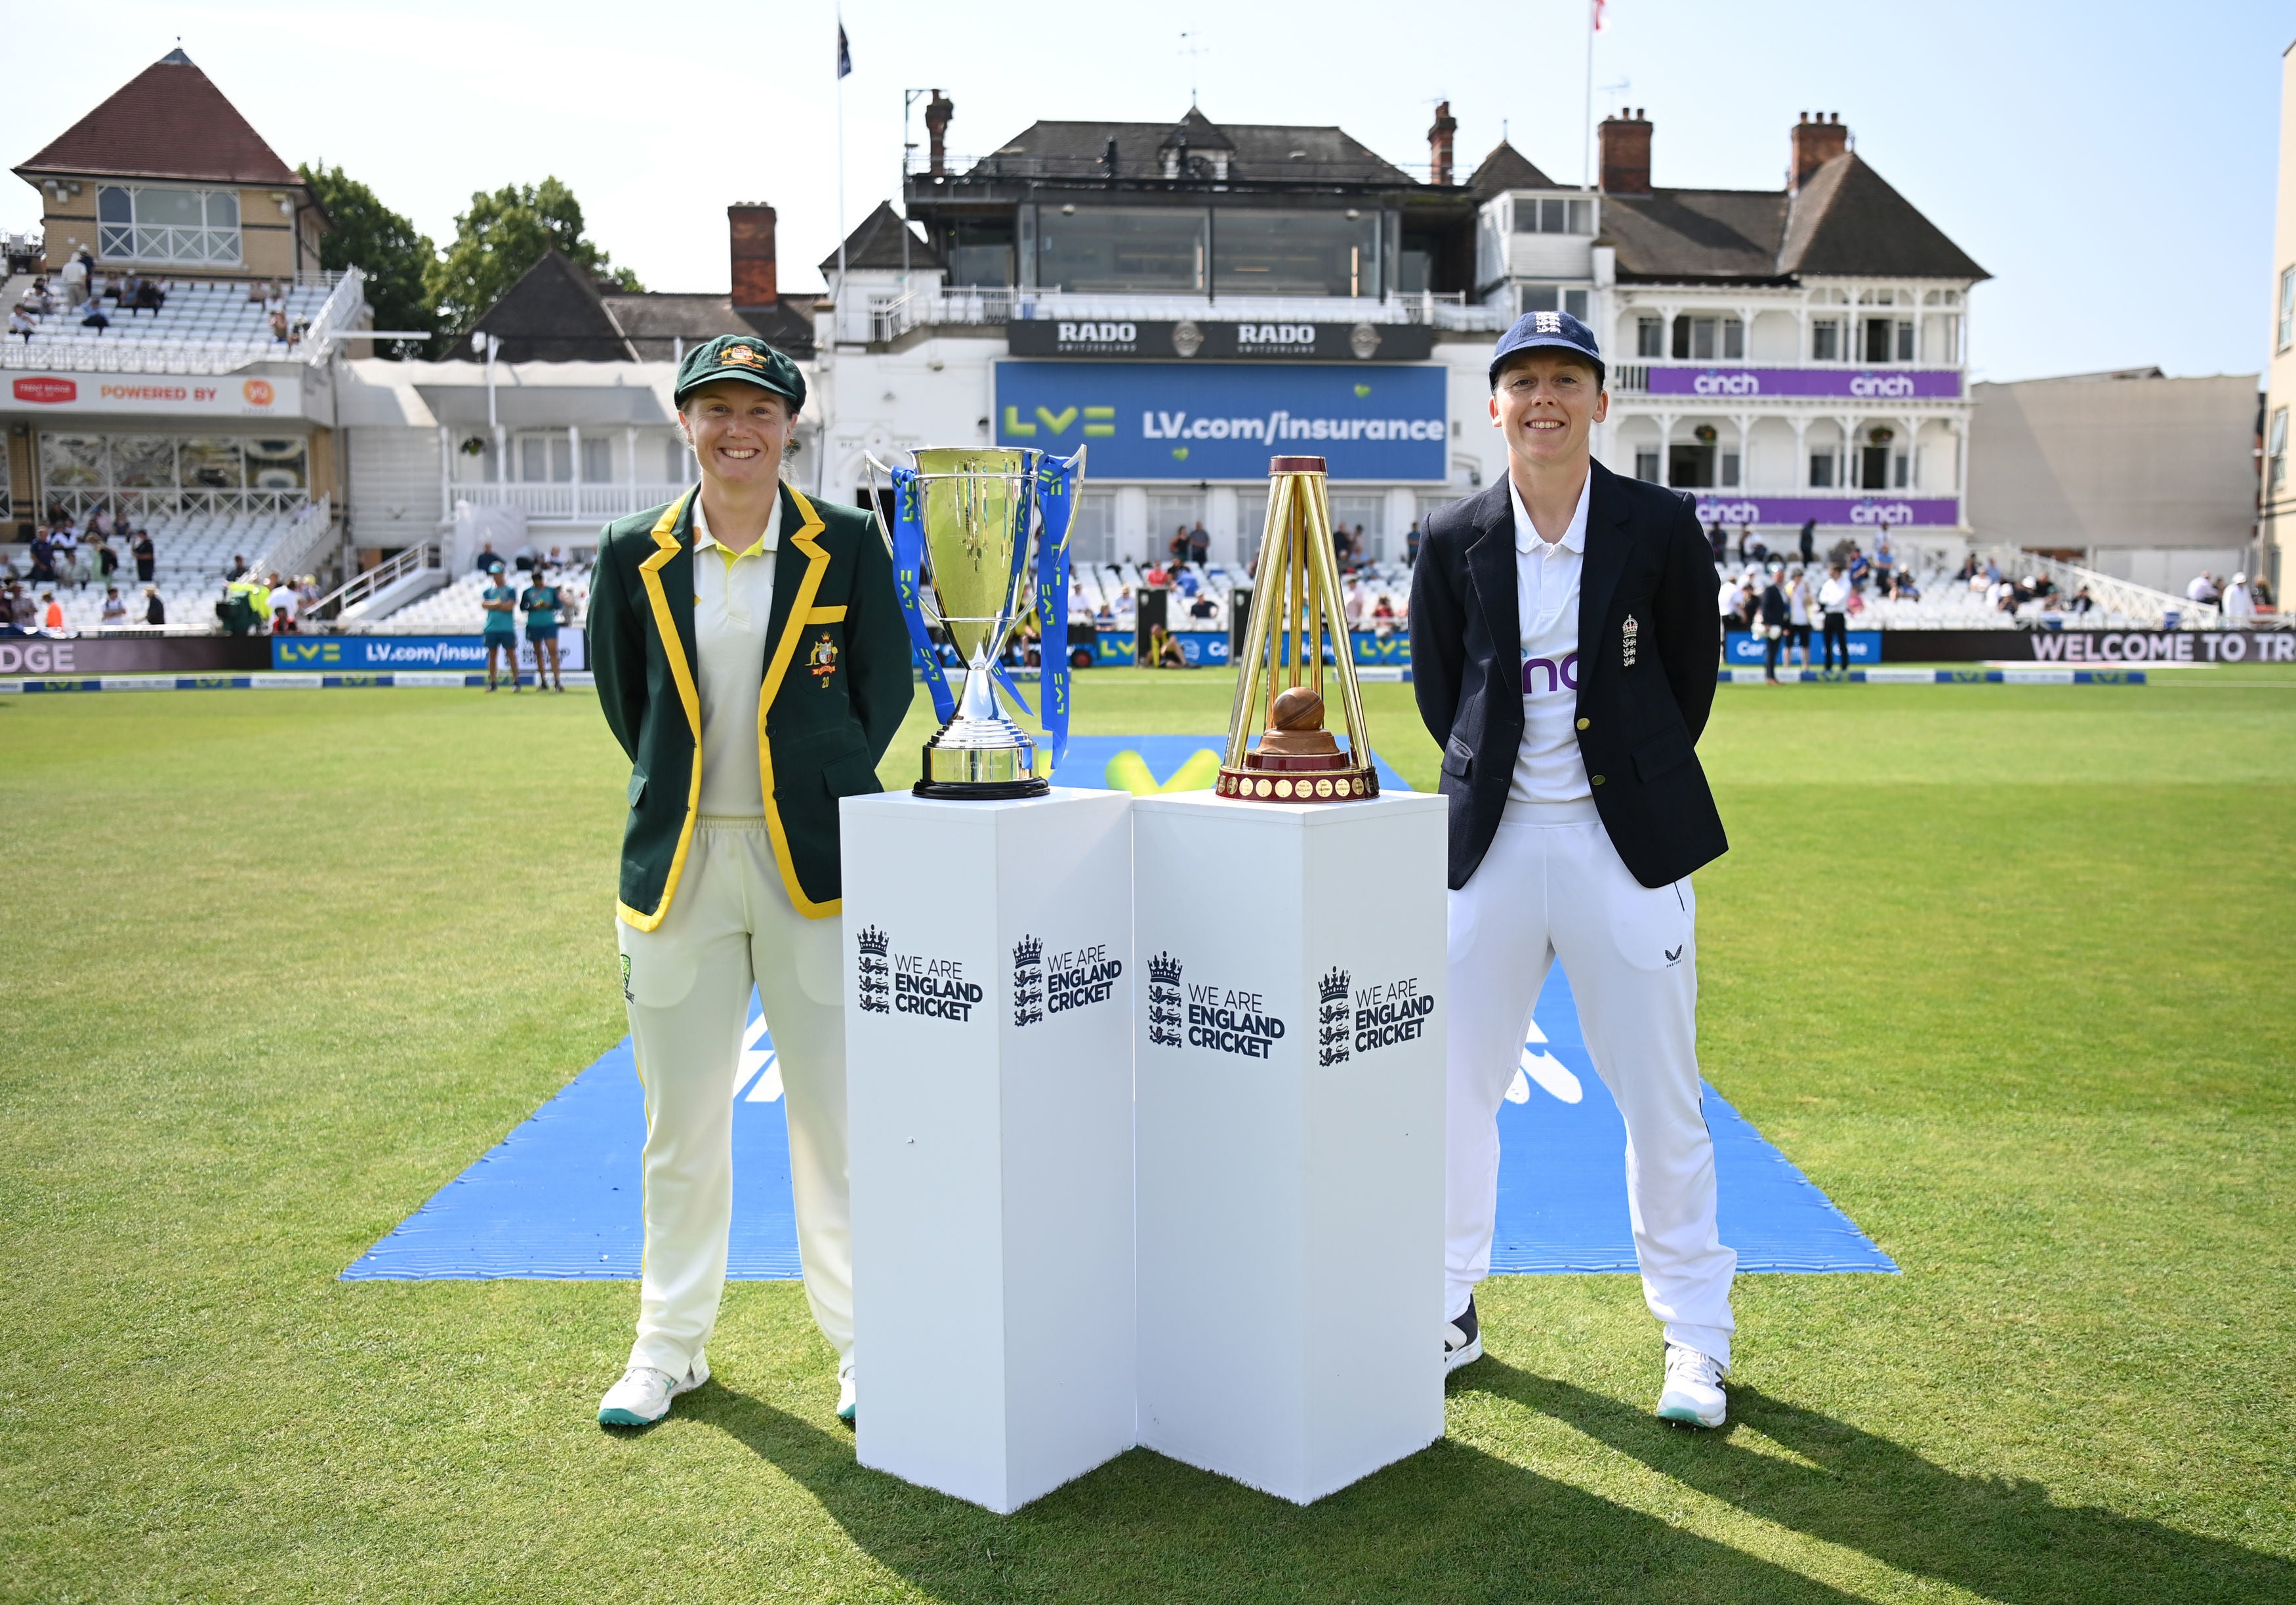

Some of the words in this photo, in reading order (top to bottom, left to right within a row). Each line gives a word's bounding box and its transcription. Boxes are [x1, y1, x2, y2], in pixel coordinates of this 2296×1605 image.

[1058, 322, 1137, 342] RADO
[1237, 324, 1316, 343] RADO
[1057, 343, 1137, 352] SWITZERLAND
[1237, 345, 1316, 354] SWITZERLAND
[101, 385, 186, 400] POWERED
[194, 387, 217, 401] BY
[1694, 370, 1759, 394] cinch
[1849, 372, 1915, 396] cinch
[1143, 411, 1445, 446] LV.com/insurance
[1696, 499, 1760, 524] cinch
[1850, 500, 1914, 524] cinch
[2032, 634, 2194, 661] WELCOME
[2202, 635, 2246, 661] TO
[821, 676, 829, 688] 20
[895, 953, 922, 974] WE
[928, 959, 963, 980] ARE
[1048, 951, 1073, 972] WE
[1076, 944, 1106, 967] ARE
[895, 972, 983, 1003] ENGLAND
[1048, 959, 1122, 994] ENGLAND
[1048, 980, 1113, 1014] CRICKET
[1188, 983, 1219, 1006] WE
[1224, 990, 1263, 1014] ARE
[1355, 985, 1382, 1009] WE
[1386, 977, 1418, 1003] ARE
[895, 993, 972, 1022] CRICKET
[1188, 1003, 1285, 1039] ENGLAND
[1355, 995, 1435, 1032] ENGLAND
[1188, 1026, 1273, 1060] CRICKET
[1355, 1017, 1425, 1053] CRICKET
